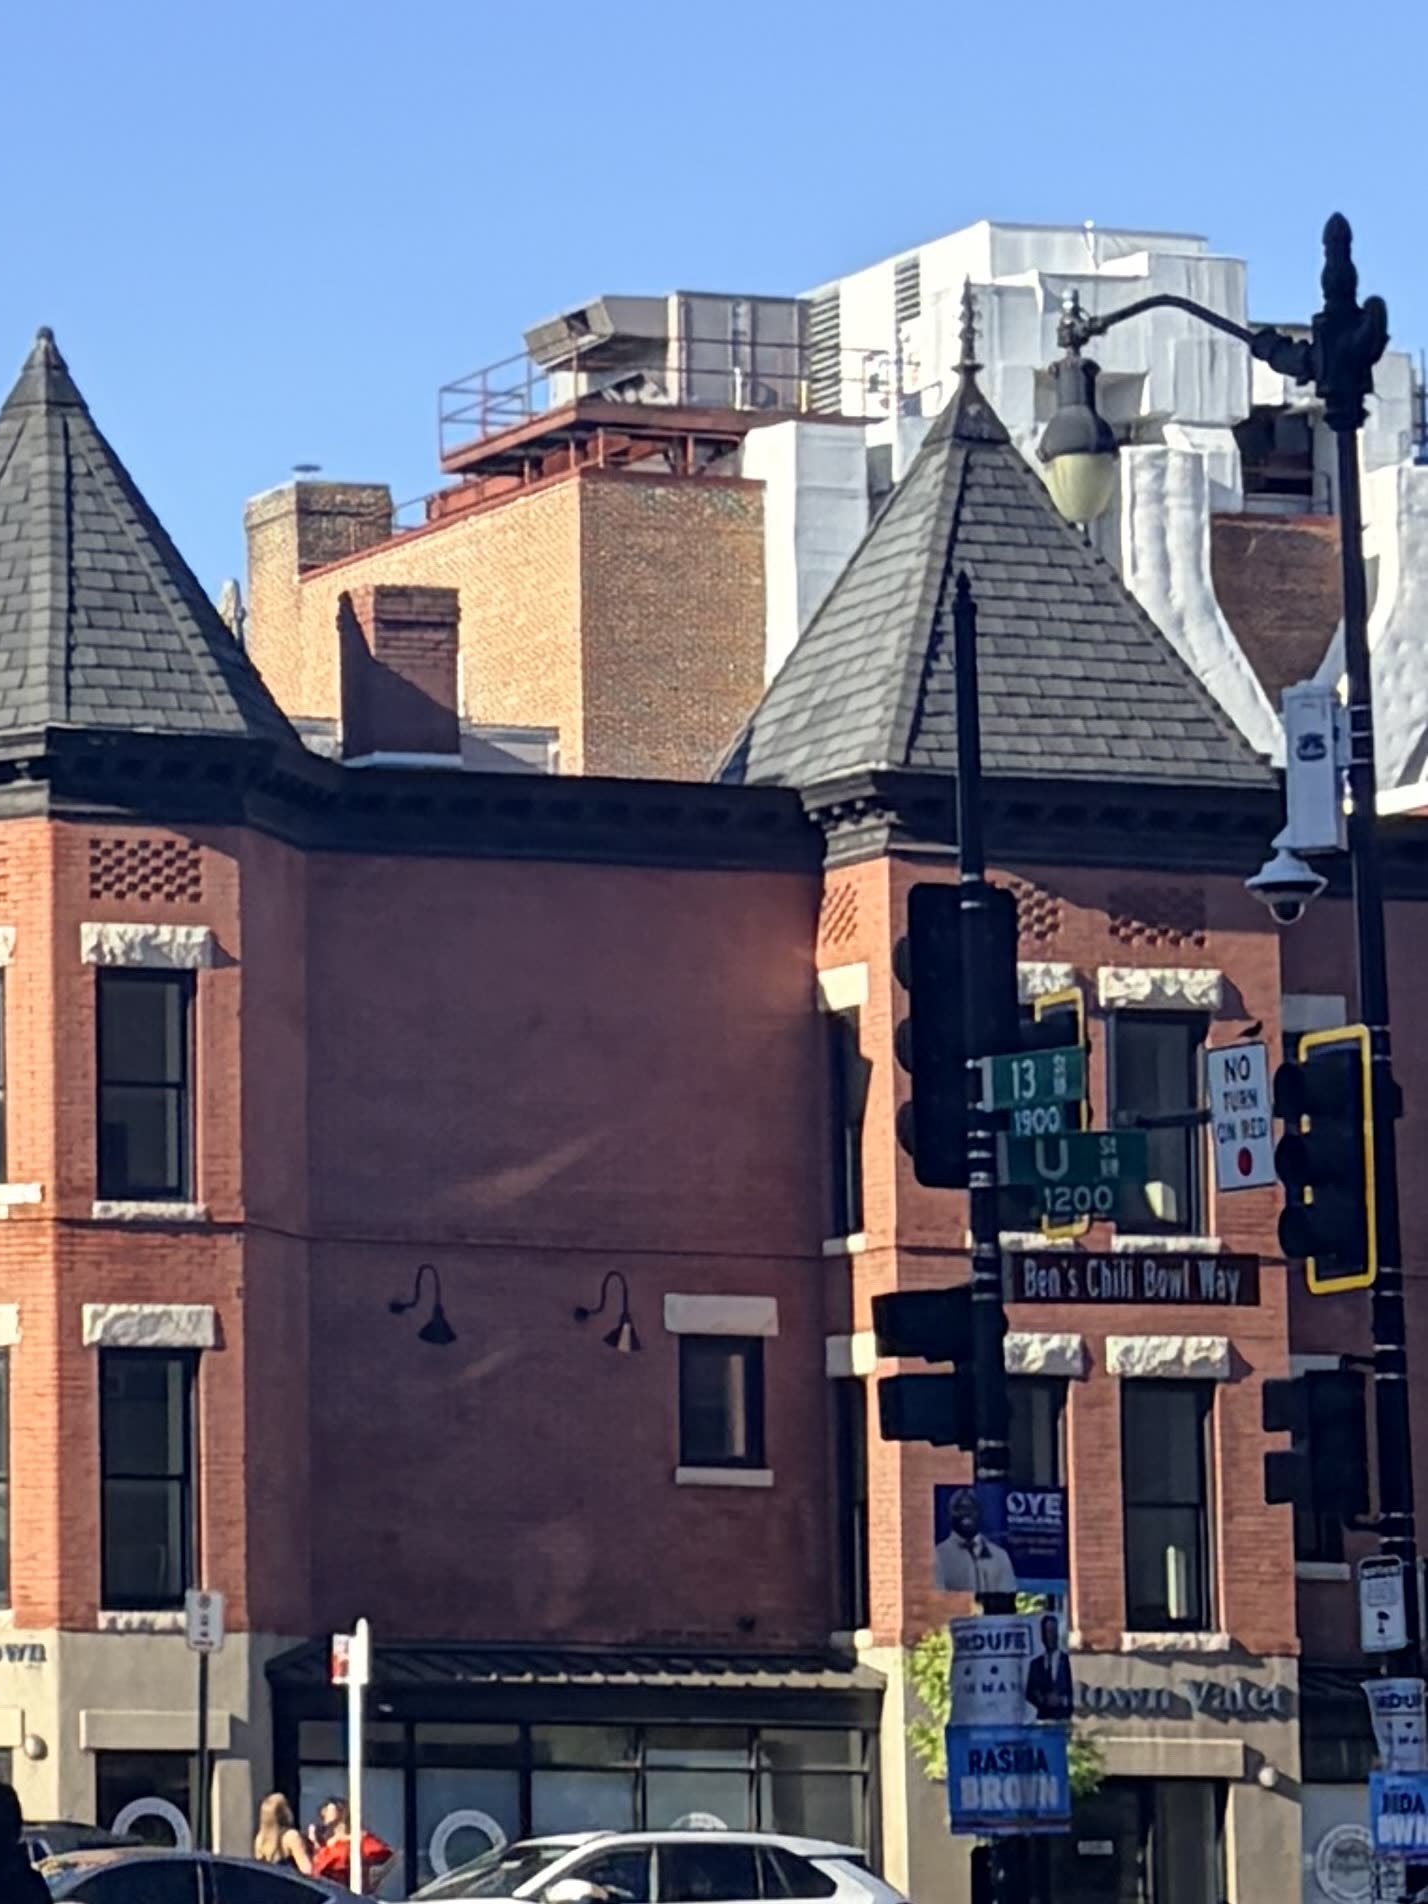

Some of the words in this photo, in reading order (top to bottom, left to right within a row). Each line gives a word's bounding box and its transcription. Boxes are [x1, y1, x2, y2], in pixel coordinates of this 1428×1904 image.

[1011, 1059, 1036, 1100] 13
[1223, 1054, 1251, 1083] NO
[1223, 1089, 1258, 1112] TURN
[1014, 1106, 1060, 1136] 1900
[1241, 1117, 1267, 1139] RED
[1035, 1136, 1069, 1182] U
[1044, 1185, 1113, 1214] 1200
[1023, 1257, 1078, 1298] Ben's
[1086, 1258, 1134, 1299] Chili
[1144, 1259, 1190, 1299] Bowl
[1198, 1260, 1241, 1305] Way
[1180, 1679, 1282, 1713] Valet
